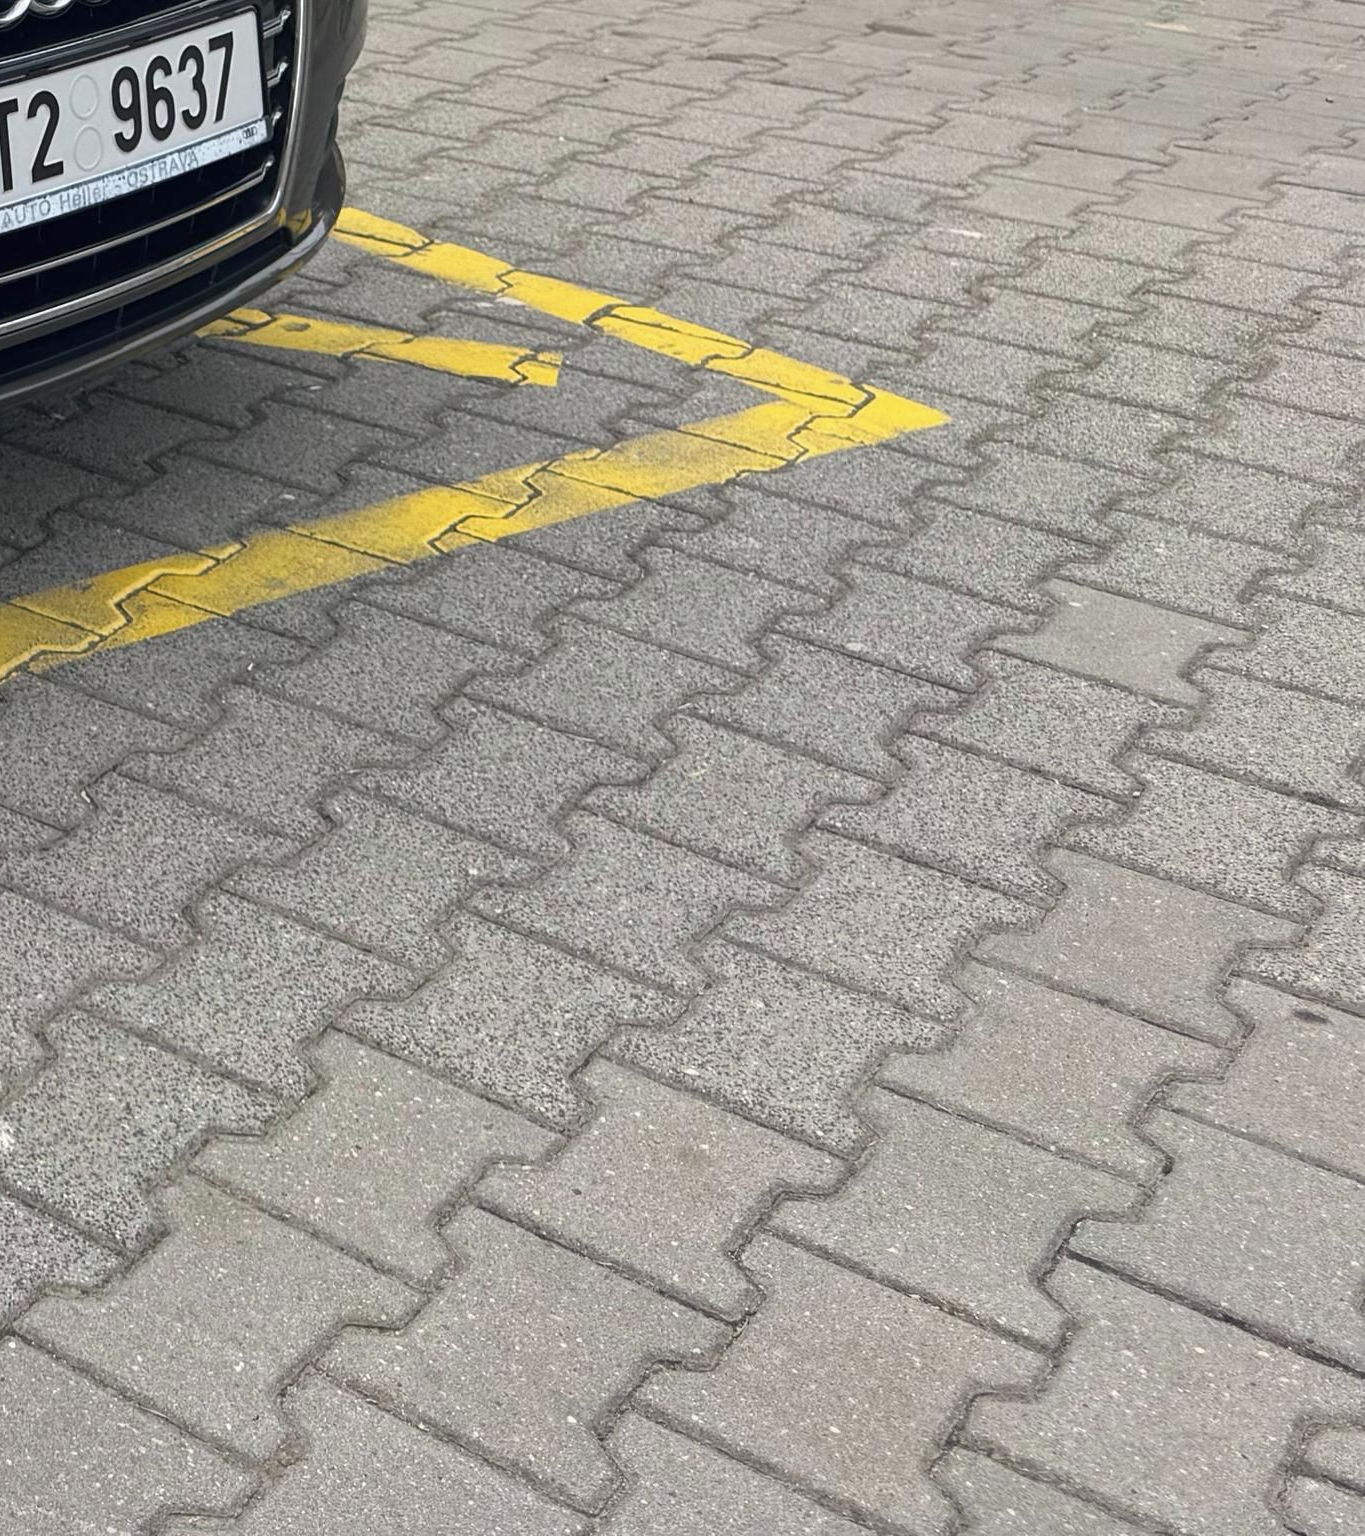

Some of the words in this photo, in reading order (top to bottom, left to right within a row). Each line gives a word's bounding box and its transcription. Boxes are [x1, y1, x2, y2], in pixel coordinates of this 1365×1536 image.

[111, 31, 234, 154] 9637
[1, 198, 52, 230] AUTO
[126, 150, 200, 188] OSTRAVA
